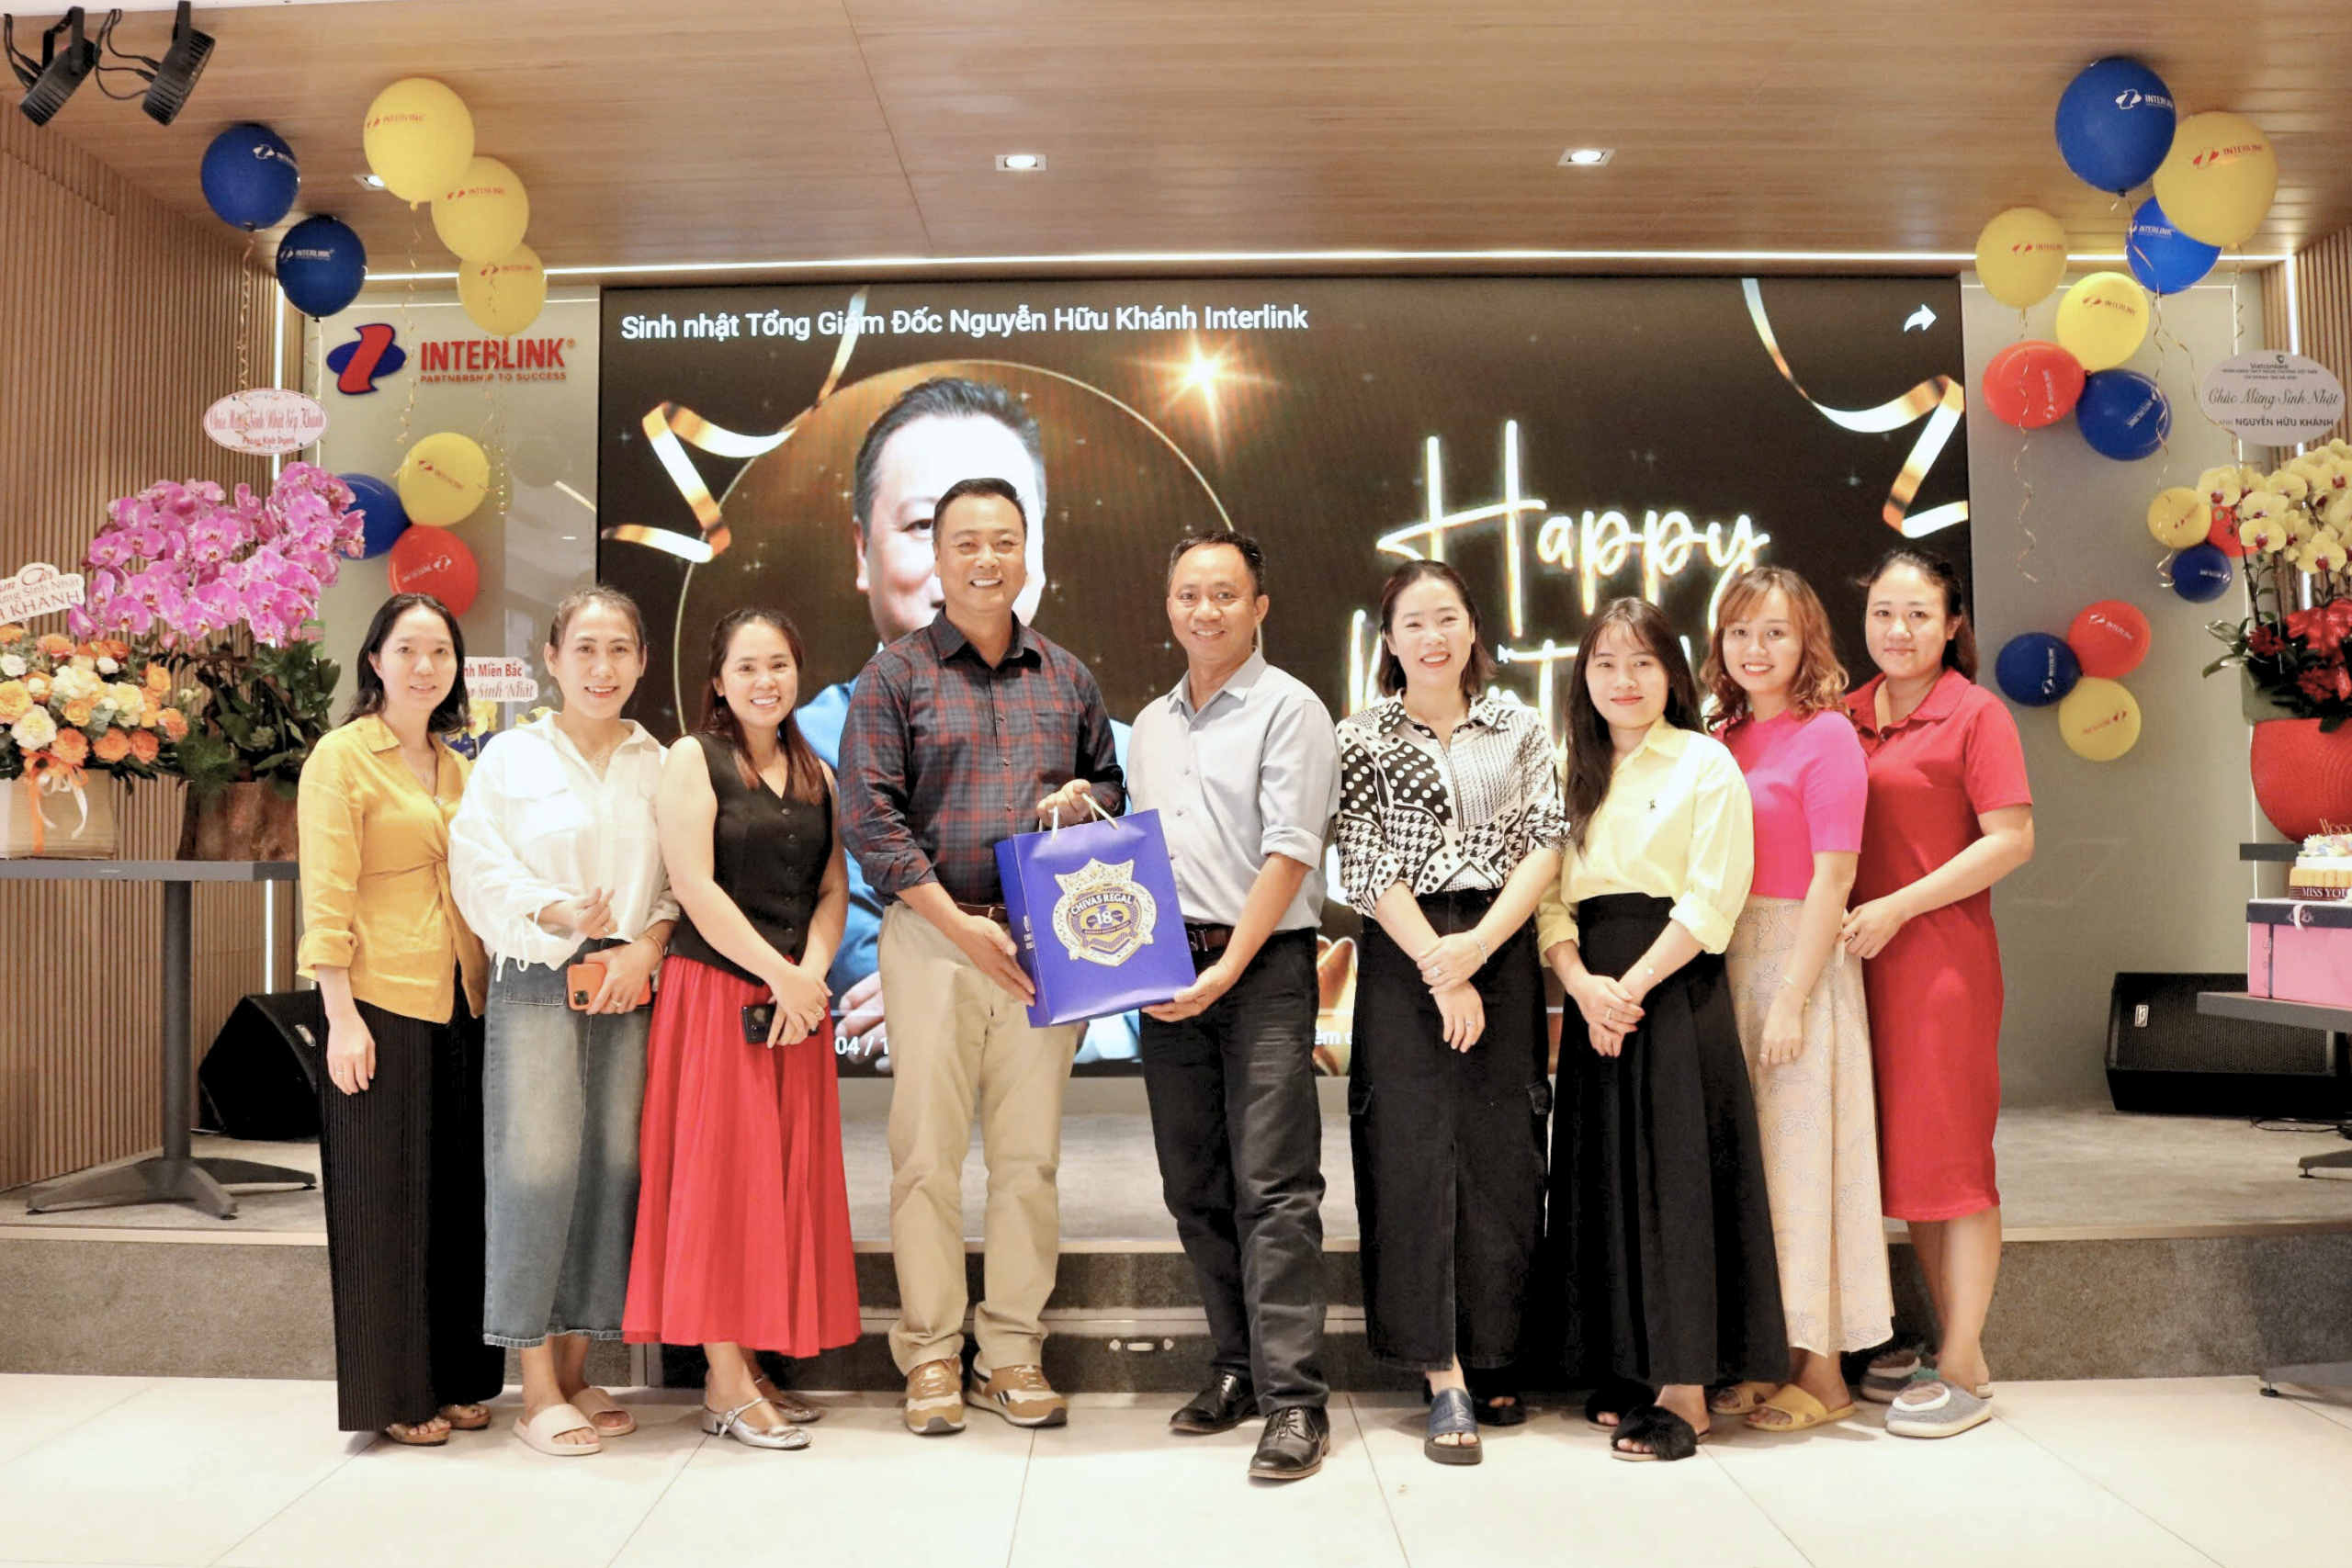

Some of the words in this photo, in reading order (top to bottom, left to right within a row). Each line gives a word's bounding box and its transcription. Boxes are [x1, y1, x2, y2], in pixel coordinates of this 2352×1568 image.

[621, 313, 676, 340] Sinh
[683, 311, 740, 342] nhật
[745, 308, 810, 341] Tổng
[818, 310, 884, 335] Giám
[889, 306, 943, 333] Đốc
[949, 304, 1047, 338] Nguyễn
[1054, 306, 1109, 332] Hữu
[1115, 304, 1197, 331] Khánh
[1204, 303, 1309, 330] Interlink
[421, 337, 566, 371] INTERLINK
[498, 372, 513, 382] TO
[516, 371, 568, 381] SUCCESS
[2208, 387, 2237, 405] Chúc
[2239, 387, 2276, 411] Mừng
[2277, 389, 2306, 406] Sinh
[2306, 389, 2340, 407] Nhật
[2234, 415, 2274, 427] NGUYỄN
[2276, 416, 2297, 427] HỮU
[2299, 415, 2335, 427] KHÁNH
[1377, 419, 1770, 637] Happy
[10, 591, 81, 616] KHÁNH
[478, 661, 503, 677] Miền
[505, 660, 523, 677] Bắc
[2301, 886, 2324, 898] MISS
[1070, 895, 1103, 916] CHIVAS
[1103, 894, 1133, 905] REGAL
[1095, 910, 1114, 926] 18
[834, 1035, 861, 1055] 04
